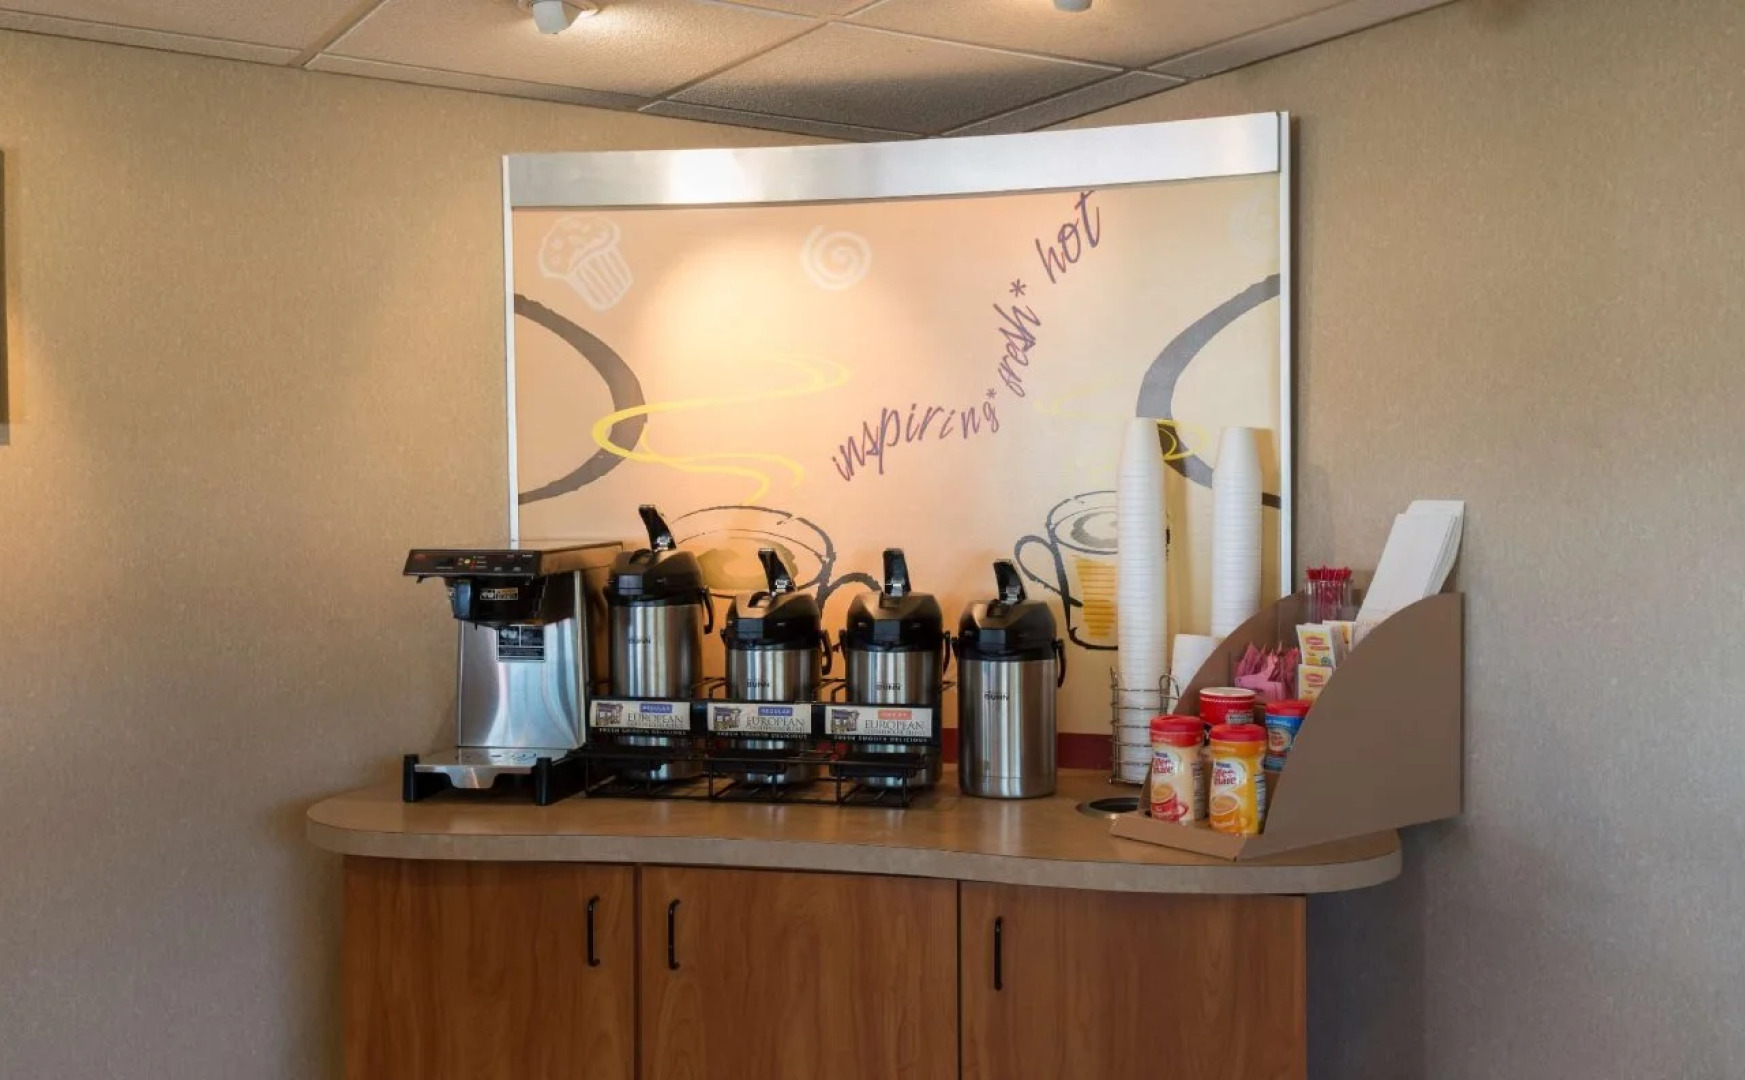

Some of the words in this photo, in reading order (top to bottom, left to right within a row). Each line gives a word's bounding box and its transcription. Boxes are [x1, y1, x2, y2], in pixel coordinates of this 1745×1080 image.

[1034, 189, 1101, 284] hot
[628, 712, 684, 724] EUROPEAN
[746, 716, 805, 727] EUROPEAN
[865, 720, 924, 731] EUROPEAN
